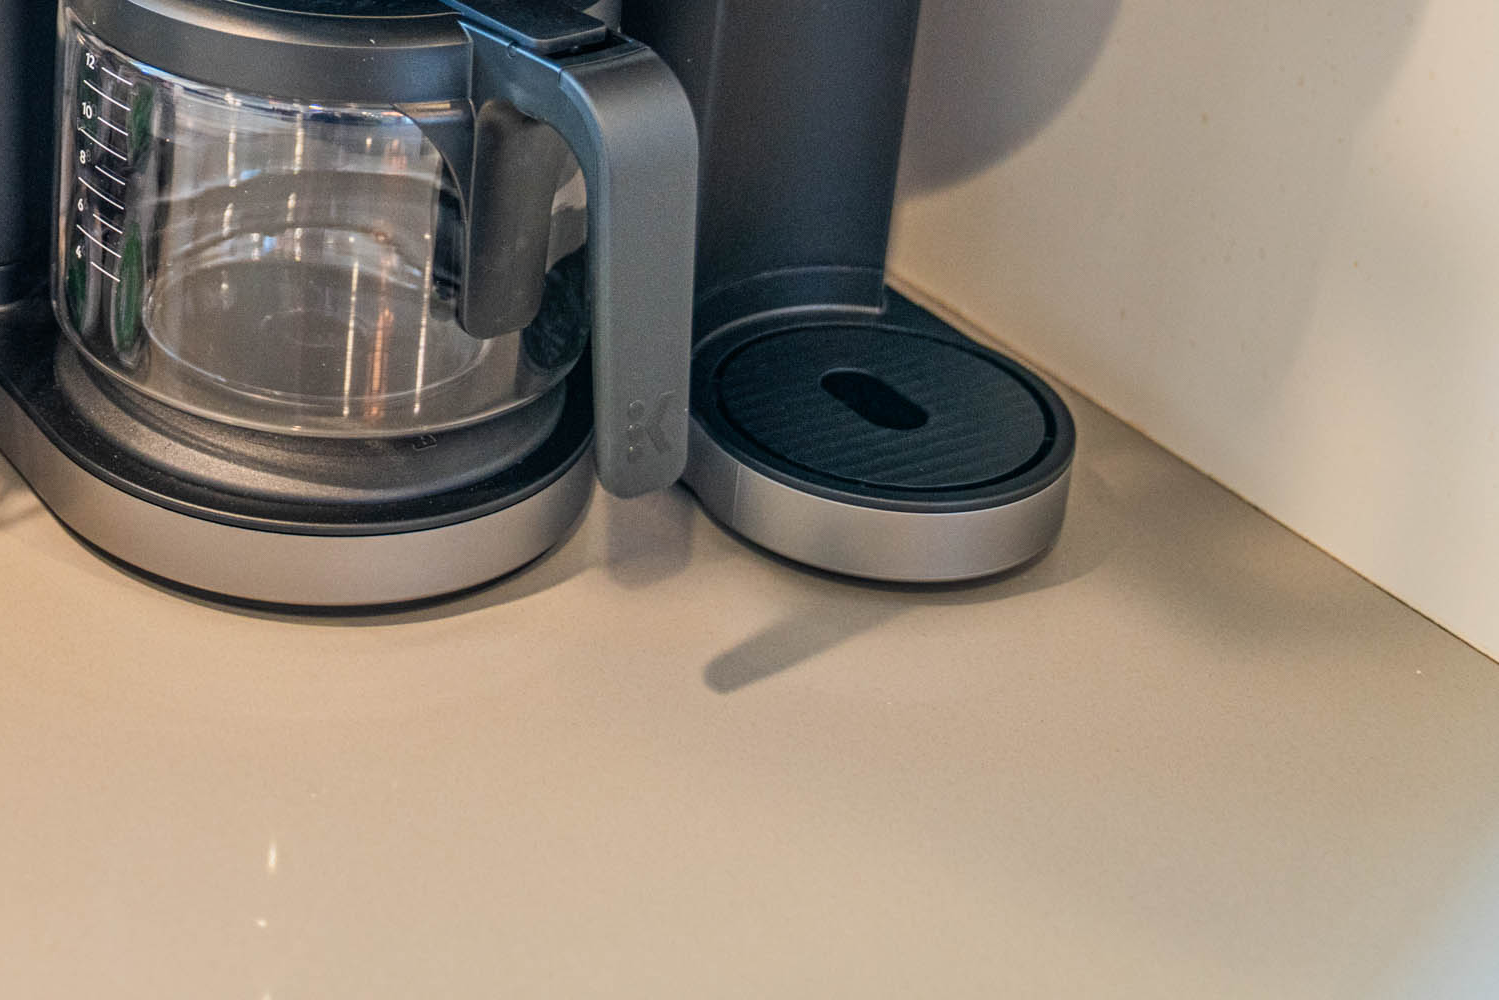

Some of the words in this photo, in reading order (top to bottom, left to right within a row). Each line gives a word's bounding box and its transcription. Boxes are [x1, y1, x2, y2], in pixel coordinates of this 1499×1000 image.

[85, 52, 95, 69] 12
[82, 102, 93, 119] 10
[79, 150, 86, 164] 8
[78, 198, 84, 211] 6
[76, 246, 82, 258] 4
